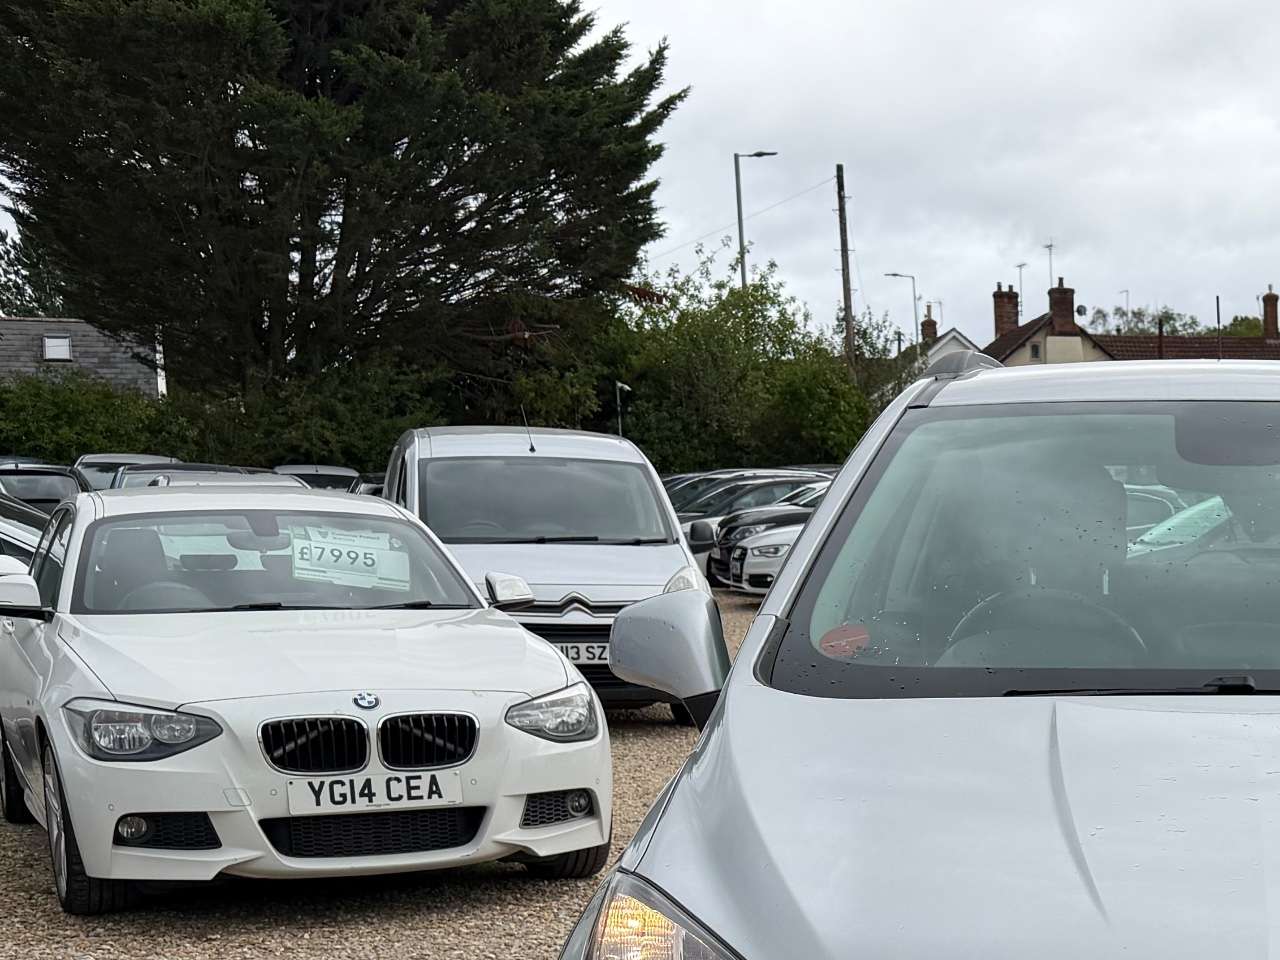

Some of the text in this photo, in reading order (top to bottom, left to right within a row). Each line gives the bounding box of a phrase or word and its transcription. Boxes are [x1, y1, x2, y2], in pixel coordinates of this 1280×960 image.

[585, 645, 608, 661] SZ
[307, 774, 443, 807] YG14 CEA
